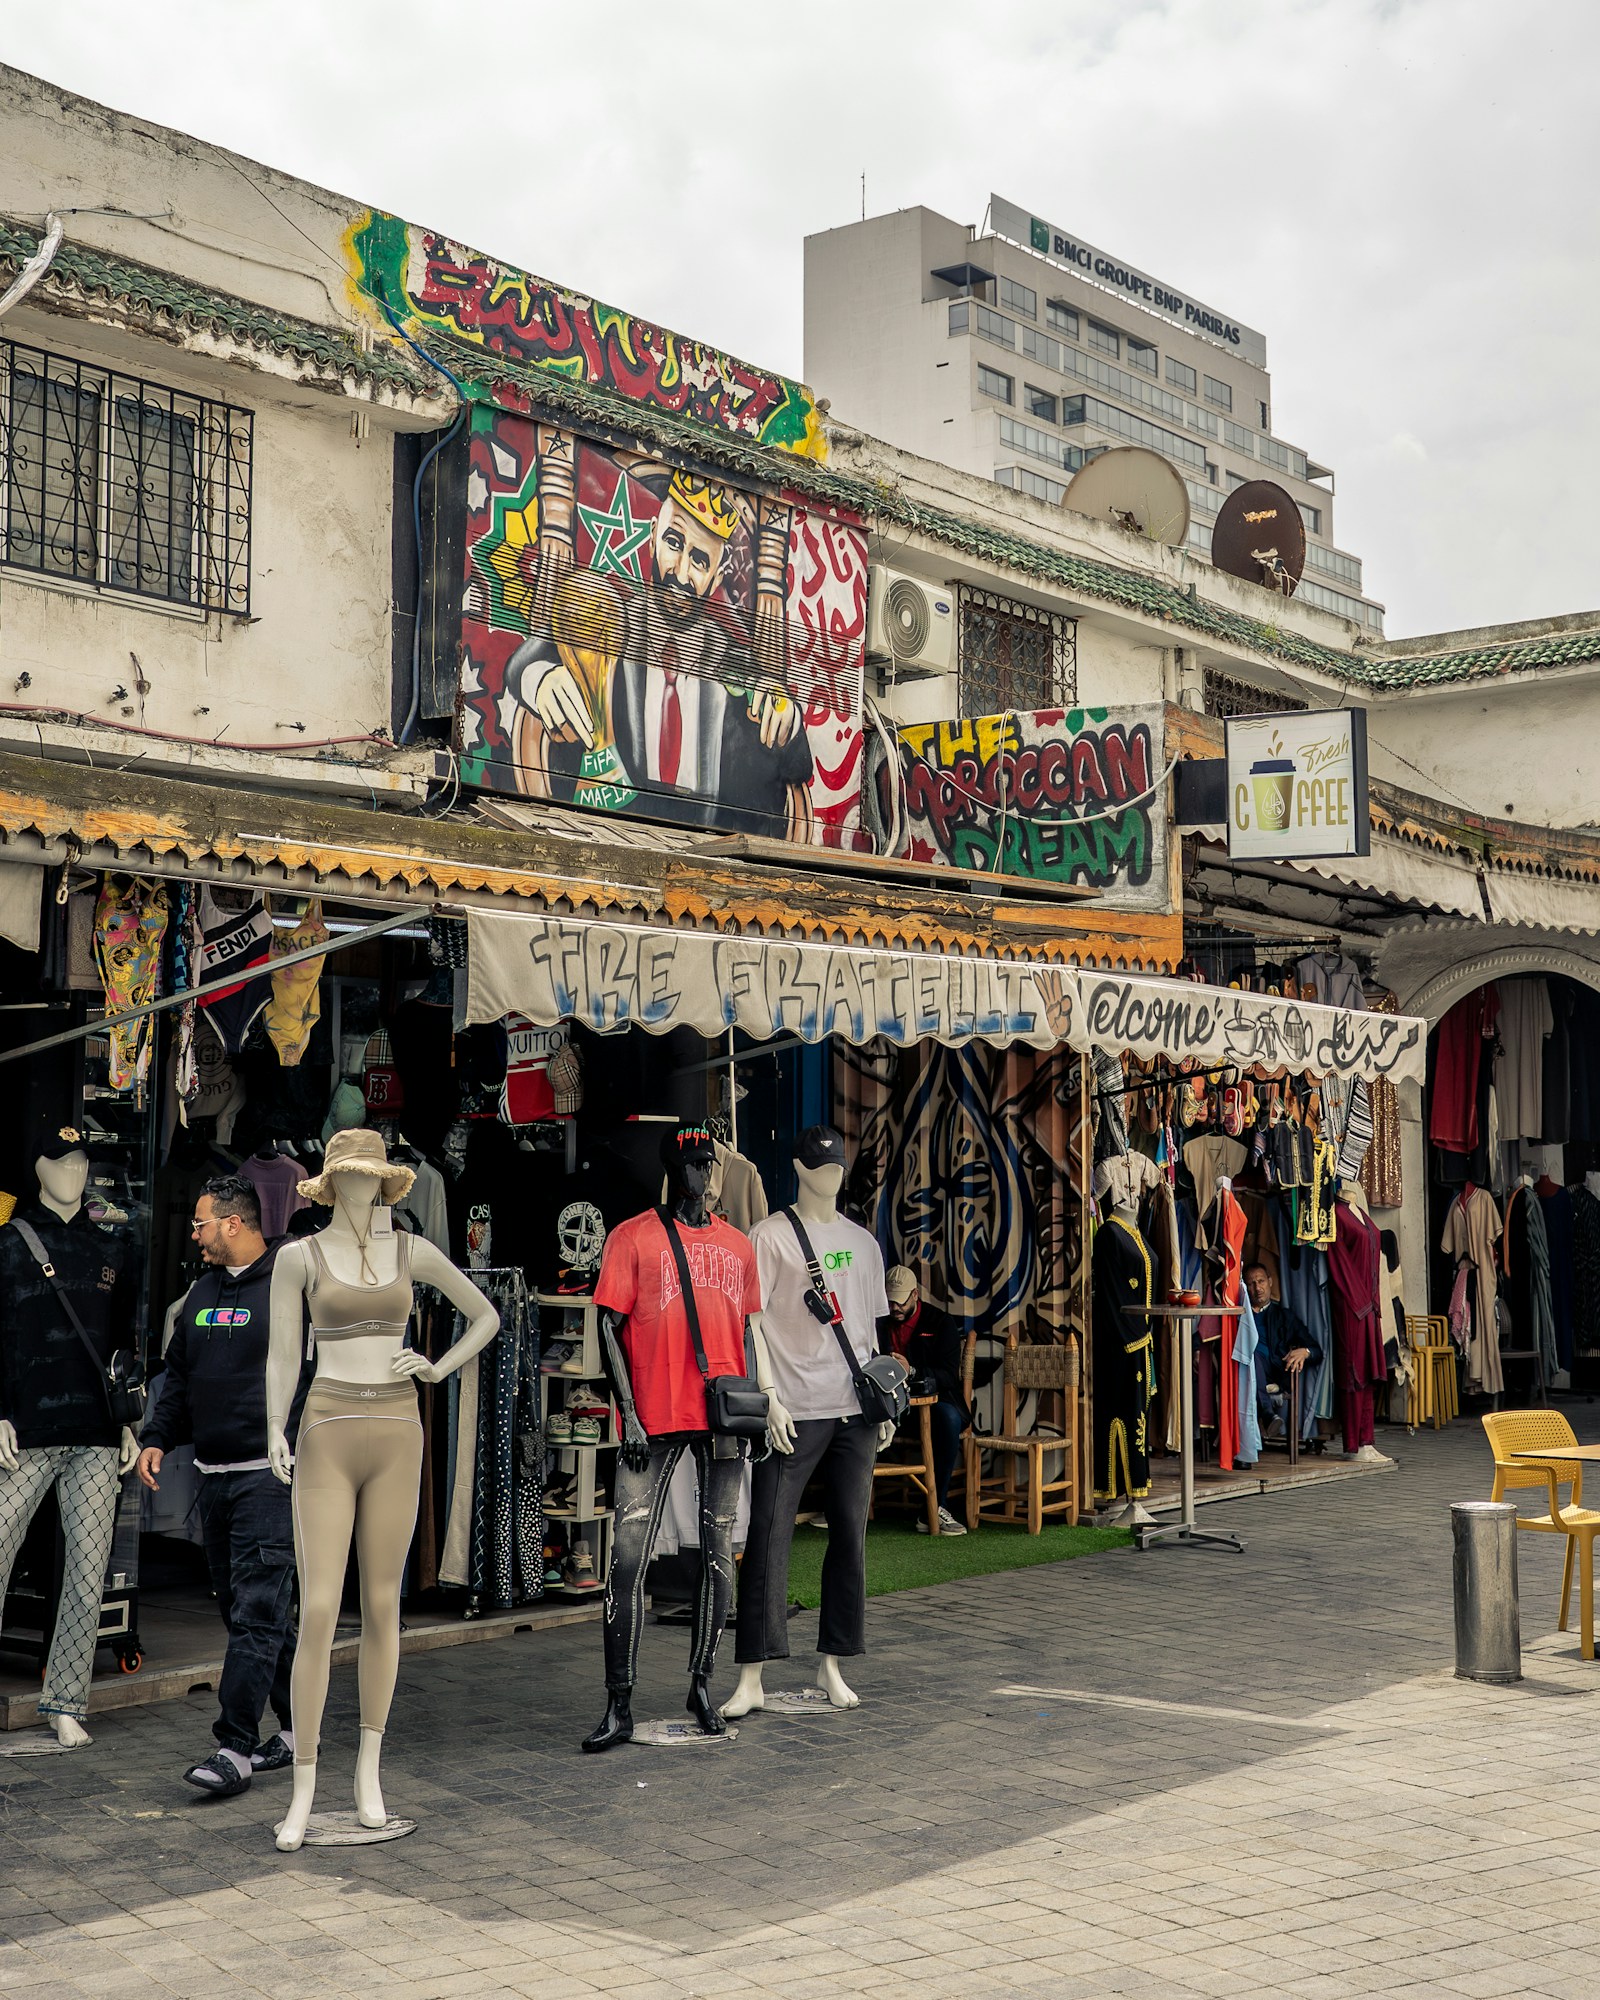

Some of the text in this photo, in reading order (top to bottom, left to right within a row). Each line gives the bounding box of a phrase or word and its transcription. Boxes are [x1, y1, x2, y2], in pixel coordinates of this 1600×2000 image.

[1054, 234, 1241, 345] BMCI GROUPE BNP PARIBAS
[899, 713, 1020, 767] THE
[1297, 733, 1350, 772] Fresh
[584, 748, 616, 773] FIFA
[580, 779, 632, 808] MAFIA
[877, 727, 1153, 848] MOROCCAN
[953, 806, 1148, 885] DREAM
[203, 923, 259, 964] FENDI
[272, 934, 318, 954] RSACE
[712, 940, 1036, 1042] FRATELLI
[198, 1081, 231, 1096] GUCC
[660, 1243, 743, 1317] AMIRI
[824, 1251, 853, 1270] OFF
[366, 1322, 380, 1330] alo
[360, 1389, 377, 1397] alo
